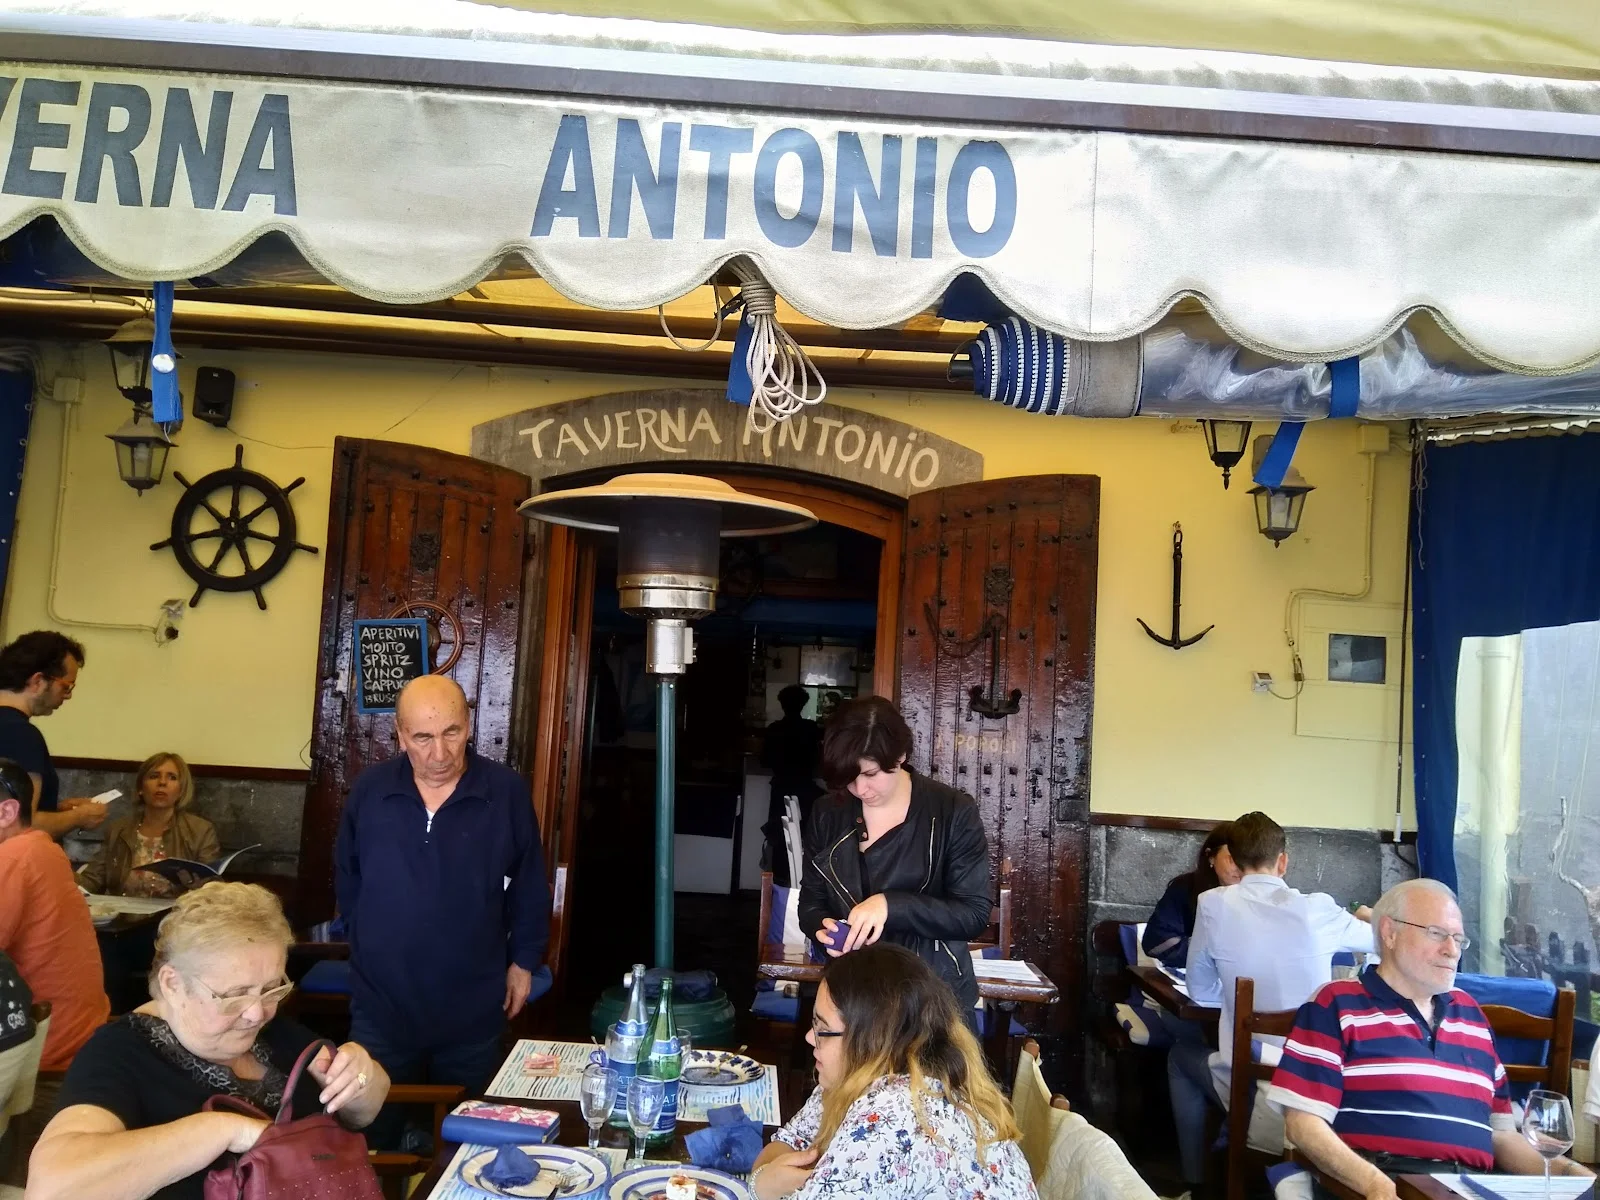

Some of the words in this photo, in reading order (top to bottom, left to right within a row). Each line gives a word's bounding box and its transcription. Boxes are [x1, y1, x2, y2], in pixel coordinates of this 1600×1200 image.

[530, 114, 1018, 259] ANTONIO
[519, 407, 722, 459] TAVERNA
[360, 625, 419, 641] APERITIVI
[361, 641, 406, 655] MOJITO
[362, 654, 414, 667] SPRITZ
[363, 667, 404, 680] VINO
